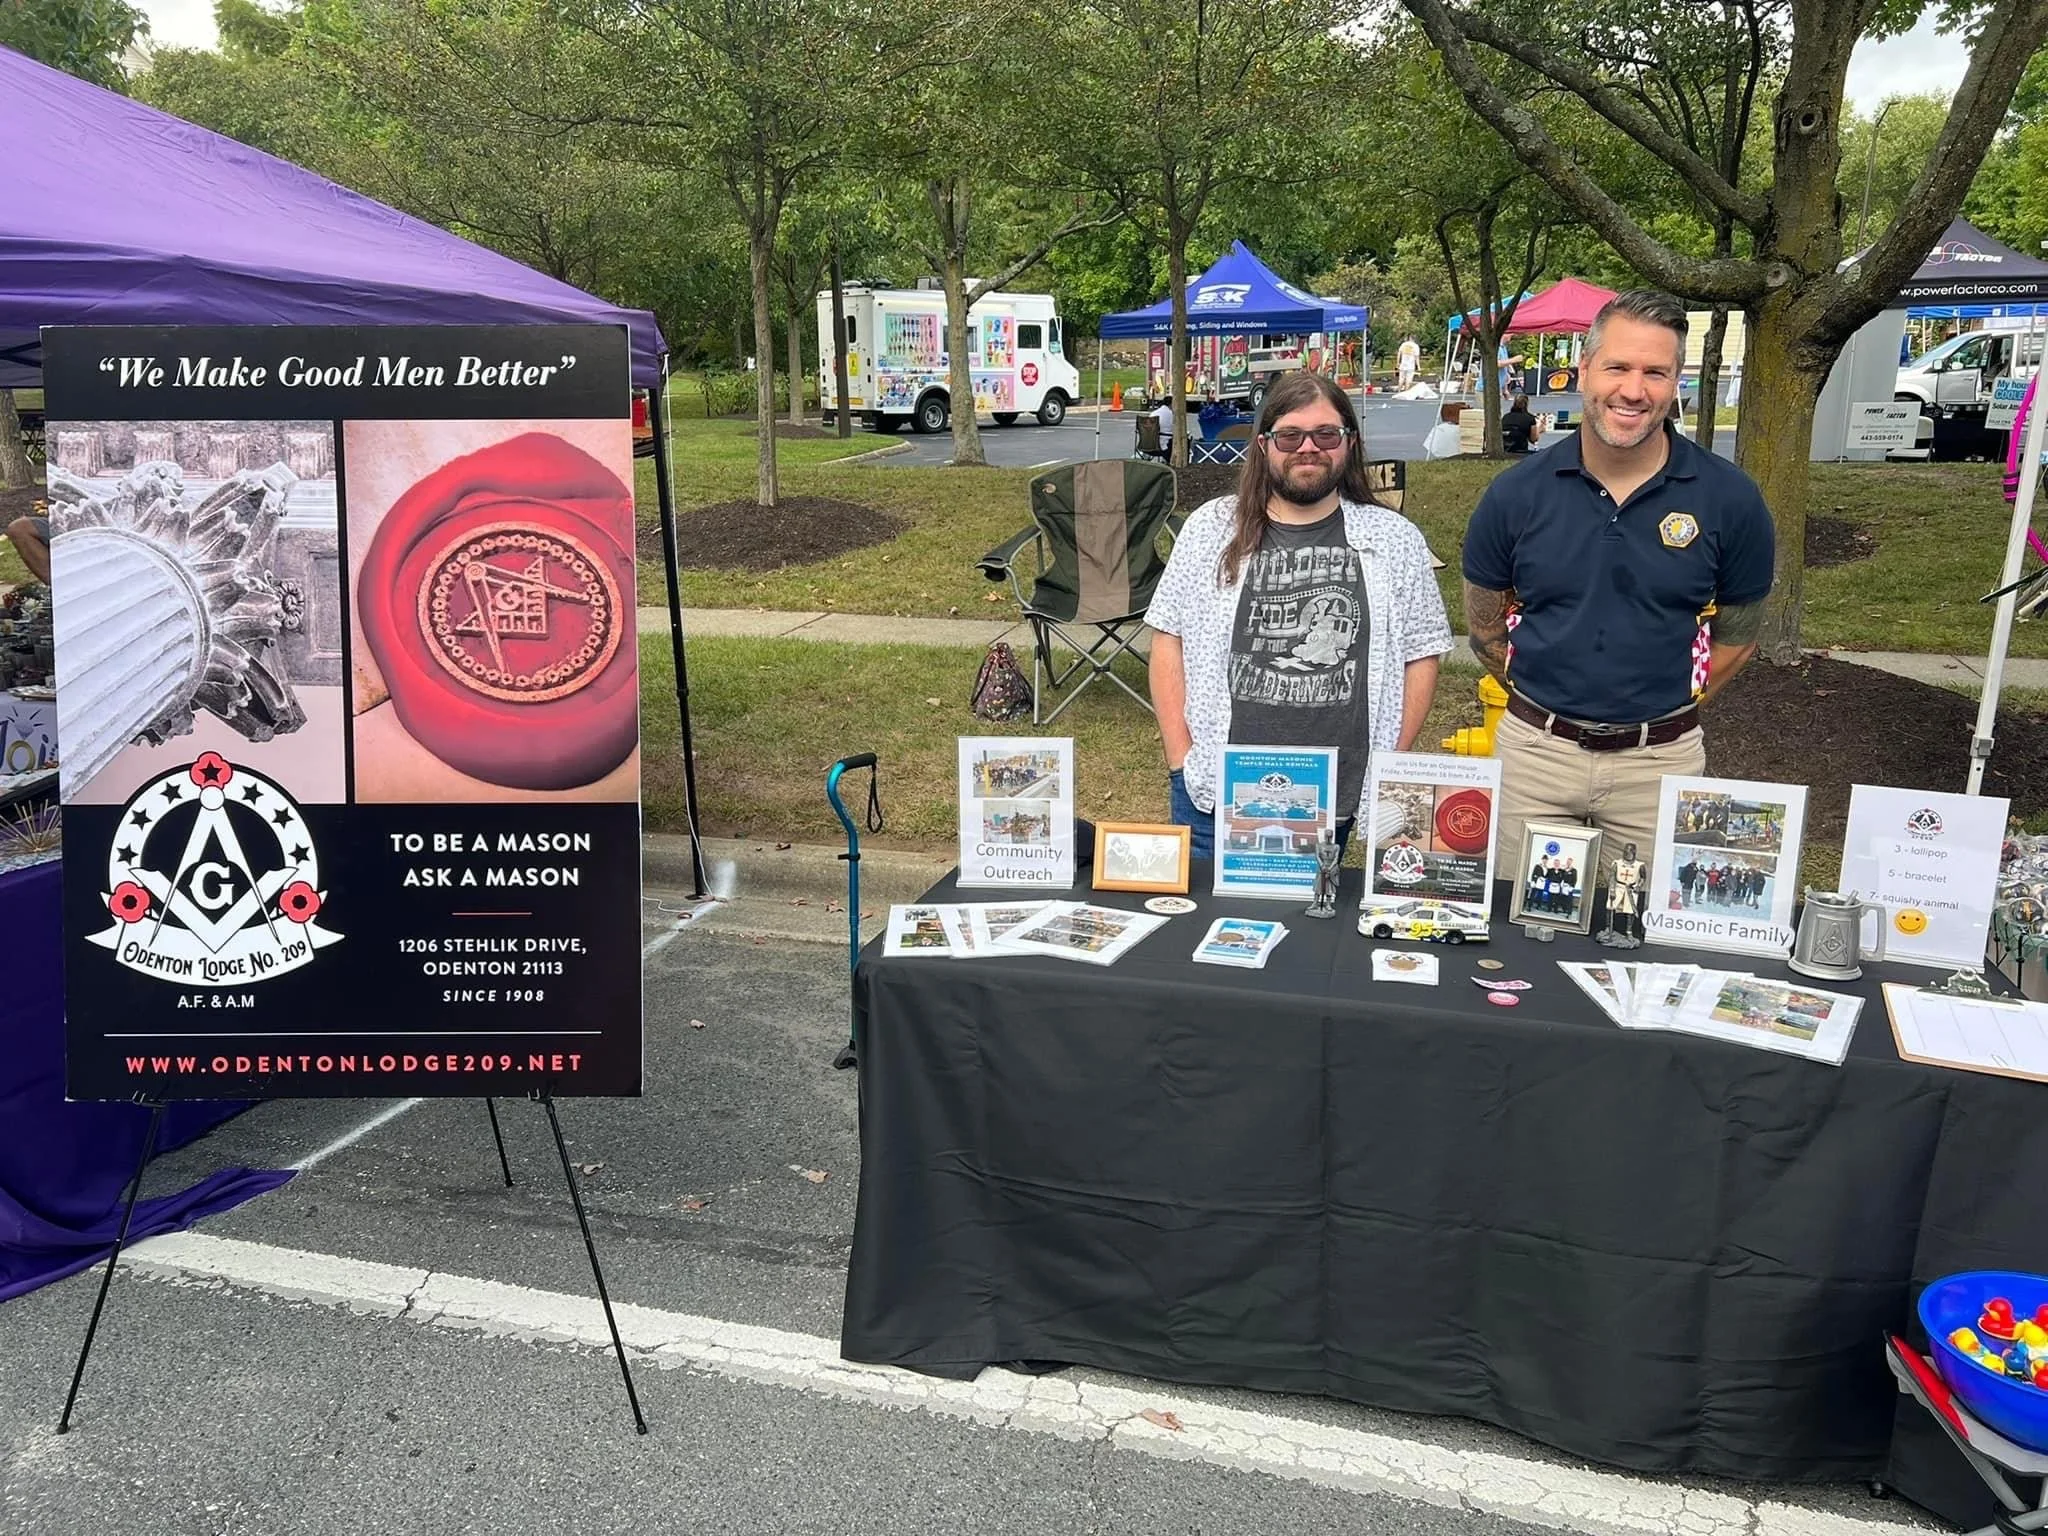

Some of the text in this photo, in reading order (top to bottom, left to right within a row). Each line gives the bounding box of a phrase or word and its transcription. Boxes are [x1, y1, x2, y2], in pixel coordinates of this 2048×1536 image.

[1194, 290, 1248, 303] S&K
[1900, 284, 2038, 297] w.powerfactorco.com
[1222, 320, 1235, 329] and
[1236, 320, 1268, 329] Windows
[100, 356, 576, 386] “We Make Good Men Better”
[1995, 389, 2026, 400] COOLE
[391, 834, 590, 852] TO BE A MASON
[976, 843, 1062, 861] Community
[1911, 845, 1948, 859] lollipop
[404, 868, 578, 886] ASK A MASON
[984, 866, 1053, 881] Outreach
[1888, 868, 1895, 878] 5
[1904, 870, 1947, 884] bracelet
[191, 862, 232, 909] G
[1882, 892, 1921, 907] squishy
[1923, 898, 1959, 911] animal
[1409, 920, 1434, 937] 95
[1645, 911, 1791, 946] Masonic Family
[281, 940, 306, 963] 209
[400, 939, 586, 954] 1206 STEHLIK DRIVE,
[424, 962, 562, 975] ODENTON 21113
[177, 994, 255, 1008] A.F. & A.M
[443, 990, 543, 1001] SINCE 1908
[125, 1055, 582, 1075] WWW.ODENTONLODGE209.NET
